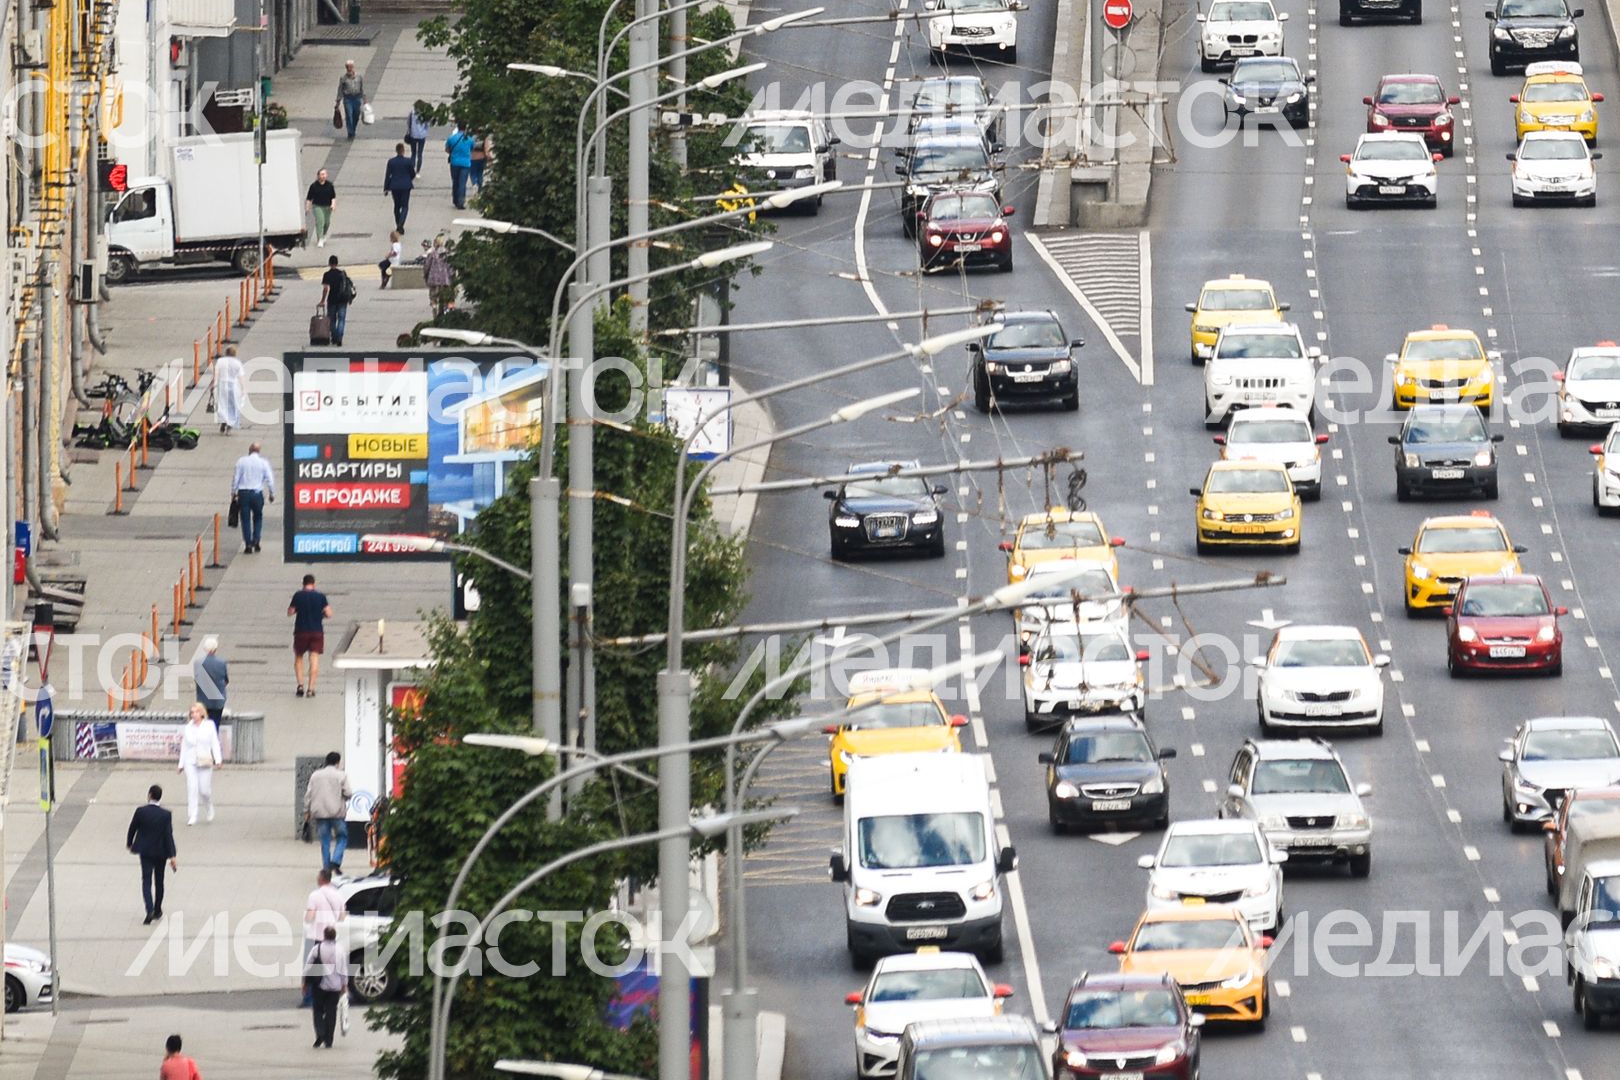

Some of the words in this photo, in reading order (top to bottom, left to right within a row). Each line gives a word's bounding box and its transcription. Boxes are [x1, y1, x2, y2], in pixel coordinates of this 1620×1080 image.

[305, 395, 417, 407] СОБЫТИЕ
[355, 439, 419, 452] НОВЫЕ
[298, 463, 402, 478] КВАРТИРЫ
[299, 489, 311, 504] В
[315, 488, 401, 508] ПРОДАЖЕ
[297, 537, 351, 552] ДОНСТРОЙ
